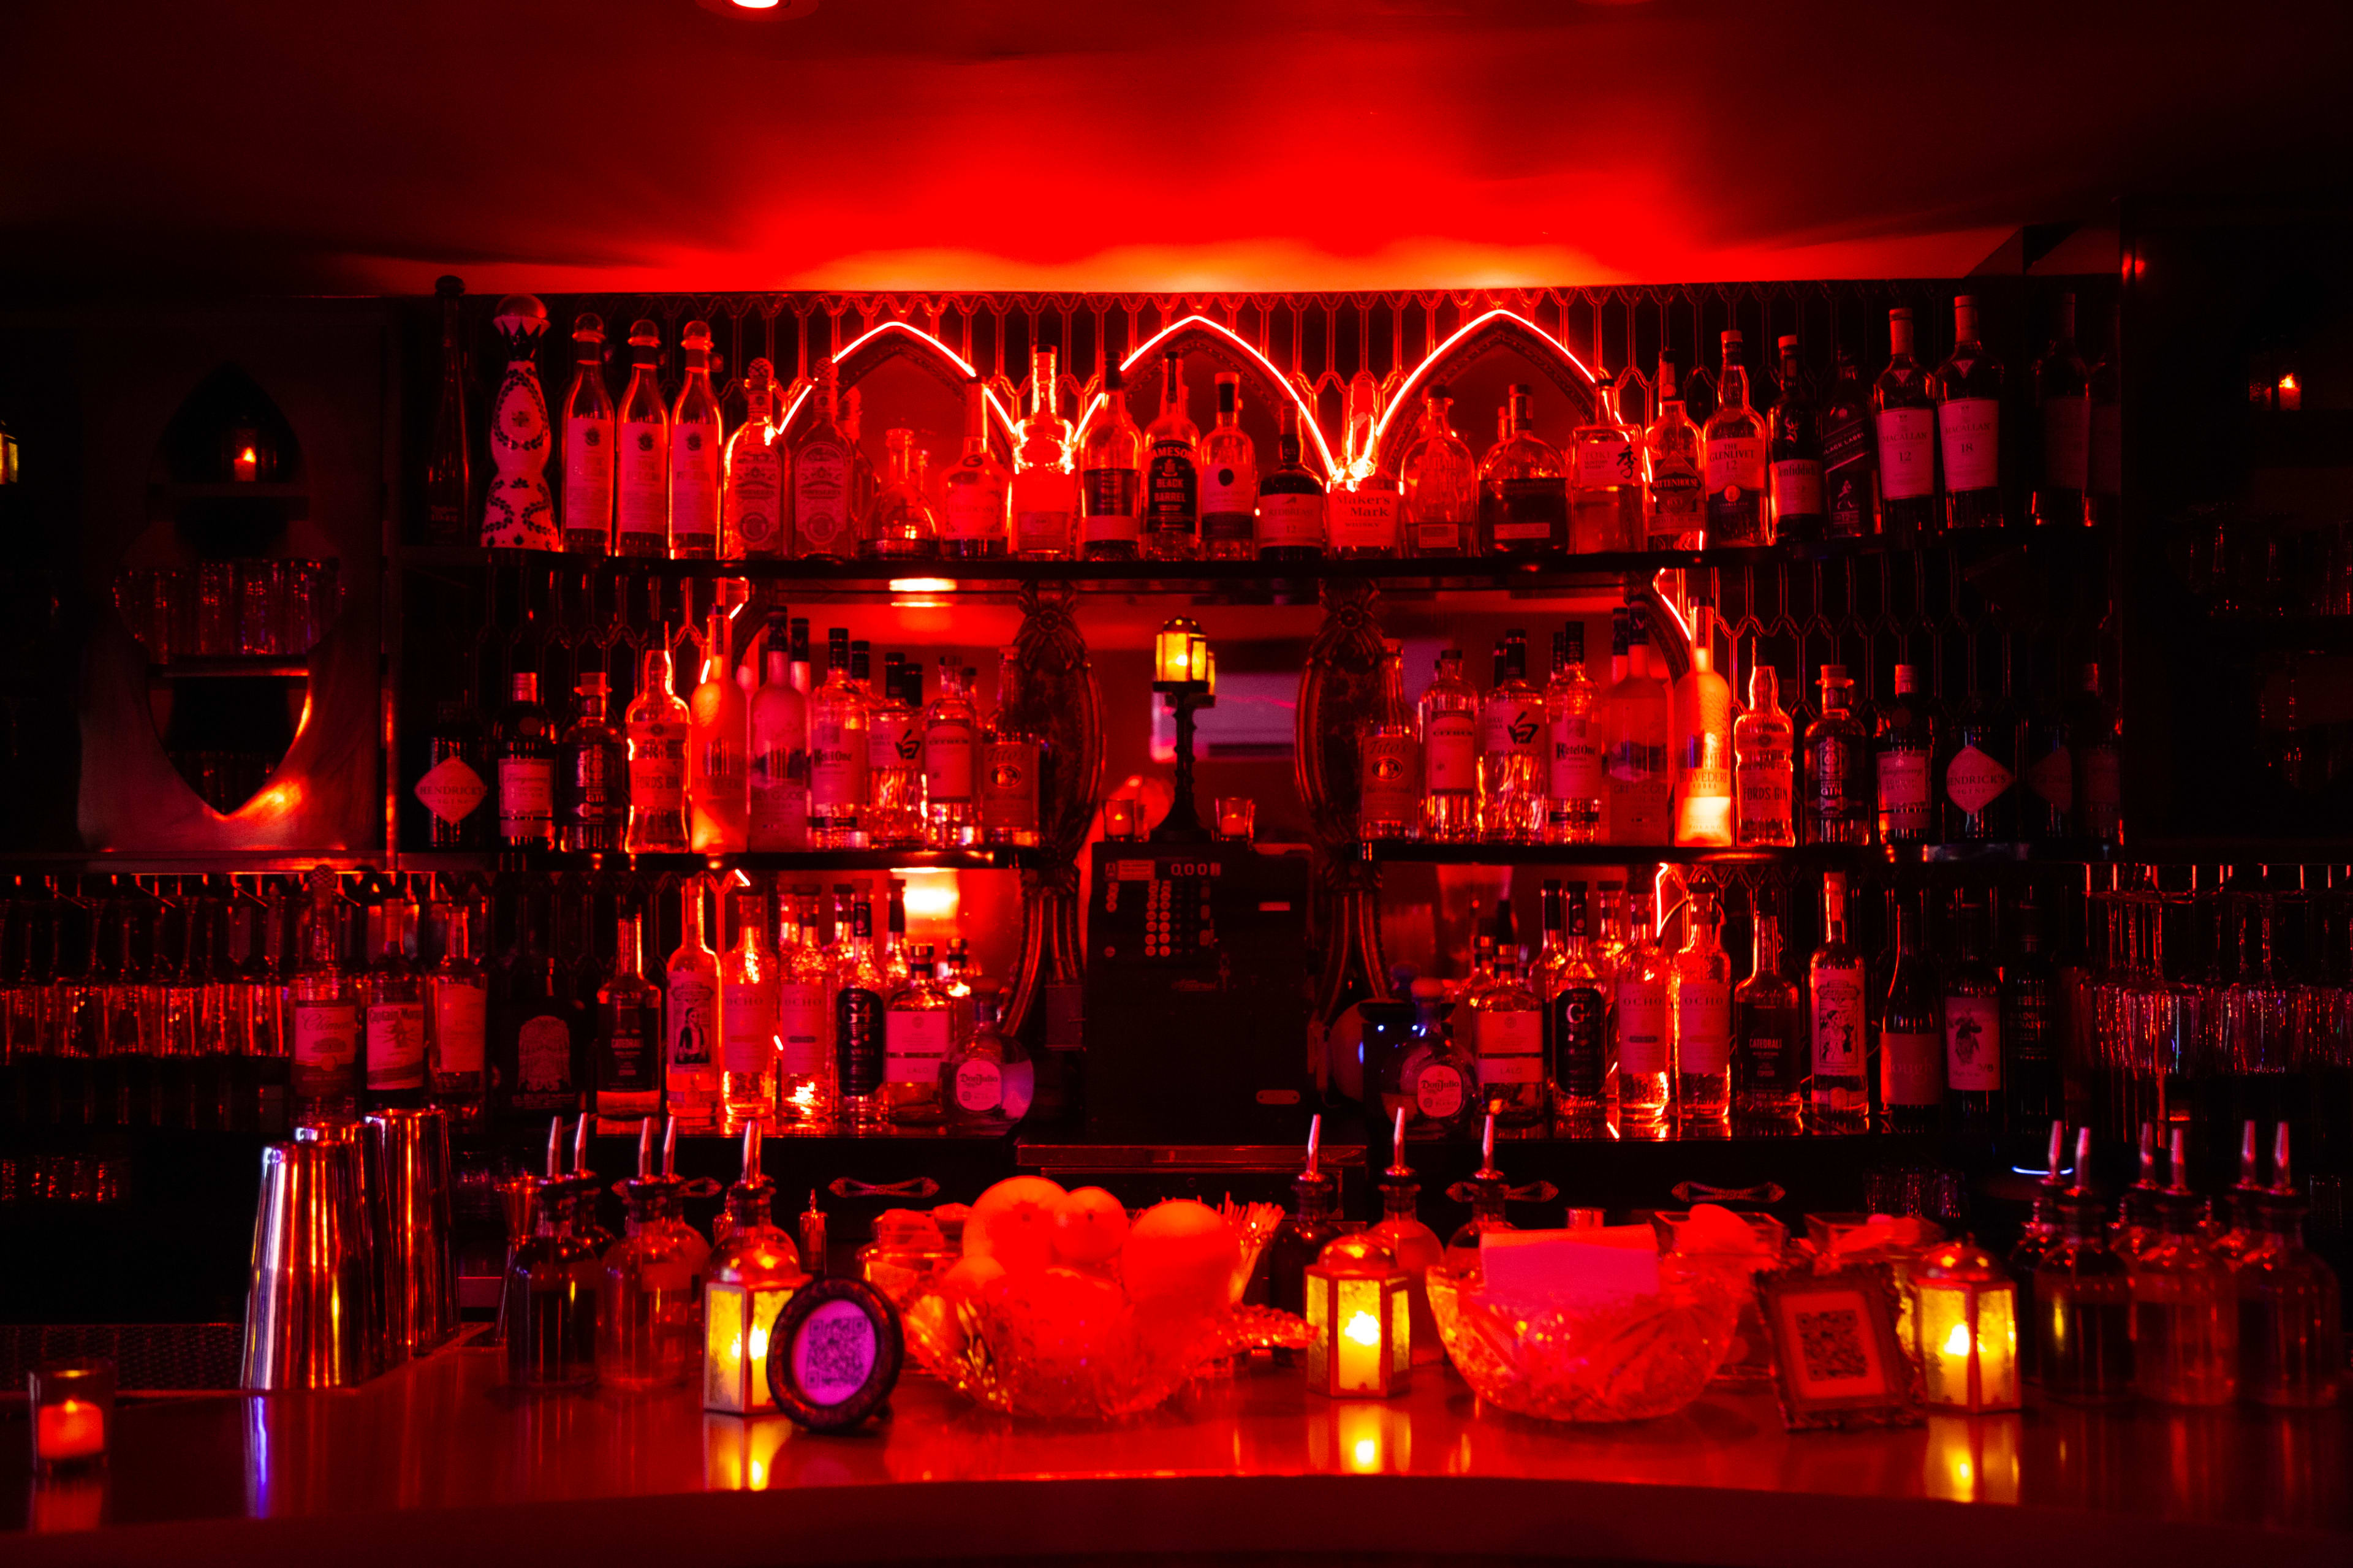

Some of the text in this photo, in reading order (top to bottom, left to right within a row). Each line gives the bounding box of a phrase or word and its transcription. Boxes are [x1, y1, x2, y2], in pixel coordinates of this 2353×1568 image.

[1946, 422, 1991, 434] MACALLAN
[1883, 431, 1930, 442] MACALLAN
[1960, 444, 1974, 453] 18
[1585, 451, 1610, 460] TOKI
[1709, 450, 1754, 462] GLENLIVET
[1898, 452, 1912, 461] 12
[1726, 460, 1738, 471] 12
[1776, 464, 1817, 478] lenfiddich
[1156, 478, 1184, 488] BLACK
[1651, 477, 1699, 490] RITTENHOUSE
[1154, 492, 1186, 502] BARREL
[1336, 494, 1391, 506] Maker's
[1349, 506, 1390, 517] Mark
[1286, 525, 1297, 534] 12
[1507, 711, 1539, 745] 白
[894, 729, 921, 760] 白
[1368, 738, 1405, 754] Tito's
[987, 747, 1026, 762] Tito's
[1556, 742, 1596, 760] Ketel One
[635, 775, 663, 790] FORDS
[1679, 771, 1729, 784] BELVEDERE
[1743, 787, 1789, 801] FORDS GIN
[1820, 787, 1843, 796] GIN
[726, 997, 765, 1006] OCHO
[784, 998, 822, 1007] OCHO
[1623, 998, 1662, 1007] OCHO
[1684, 998, 1724, 1007] OCHO
[841, 1002, 873, 1024] G4
[960, 1074, 998, 1085] Don Julio
[1421, 1080, 1459, 1091] Don Julio
